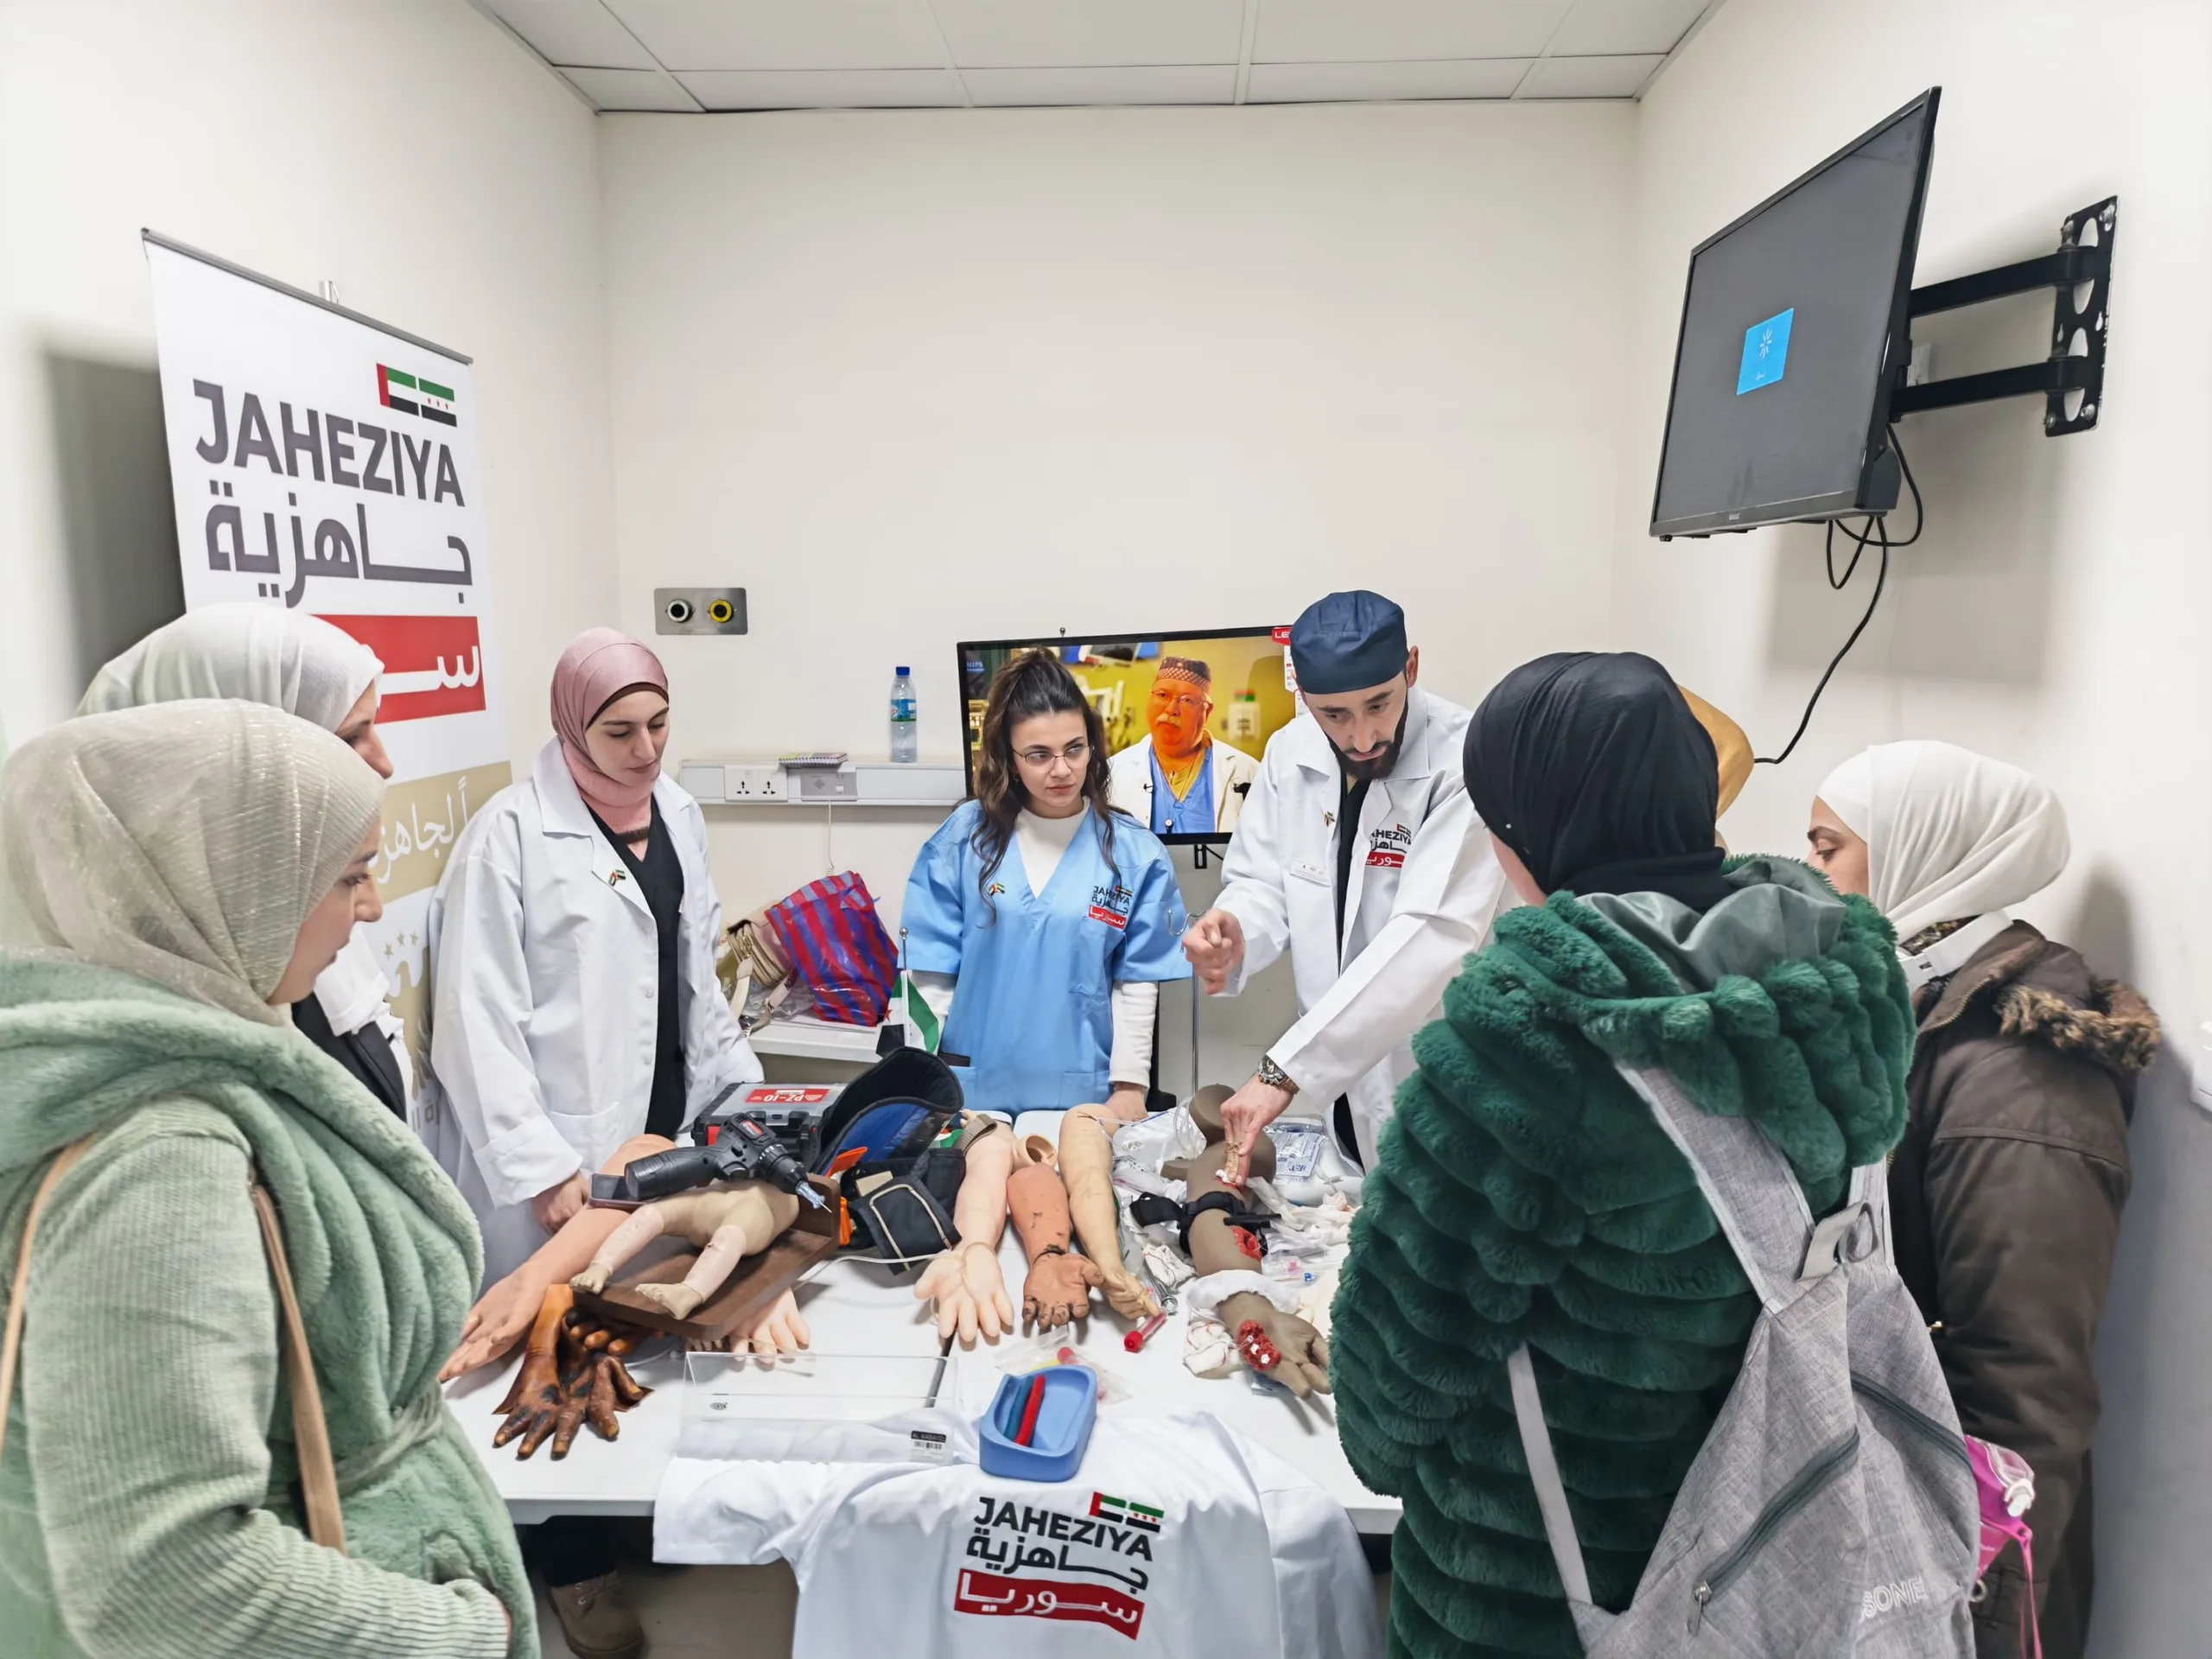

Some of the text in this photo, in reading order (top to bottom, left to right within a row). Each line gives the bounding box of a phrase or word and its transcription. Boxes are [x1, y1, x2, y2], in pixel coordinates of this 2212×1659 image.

[193, 378, 465, 507] JAHEZIYA
[205, 479, 473, 608] جاهزية
[966, 1527, 1148, 1594] جاهزية
[974, 1497, 1153, 1561] JAHEZIYA
[960, 1573, 1138, 1624] سوريا
